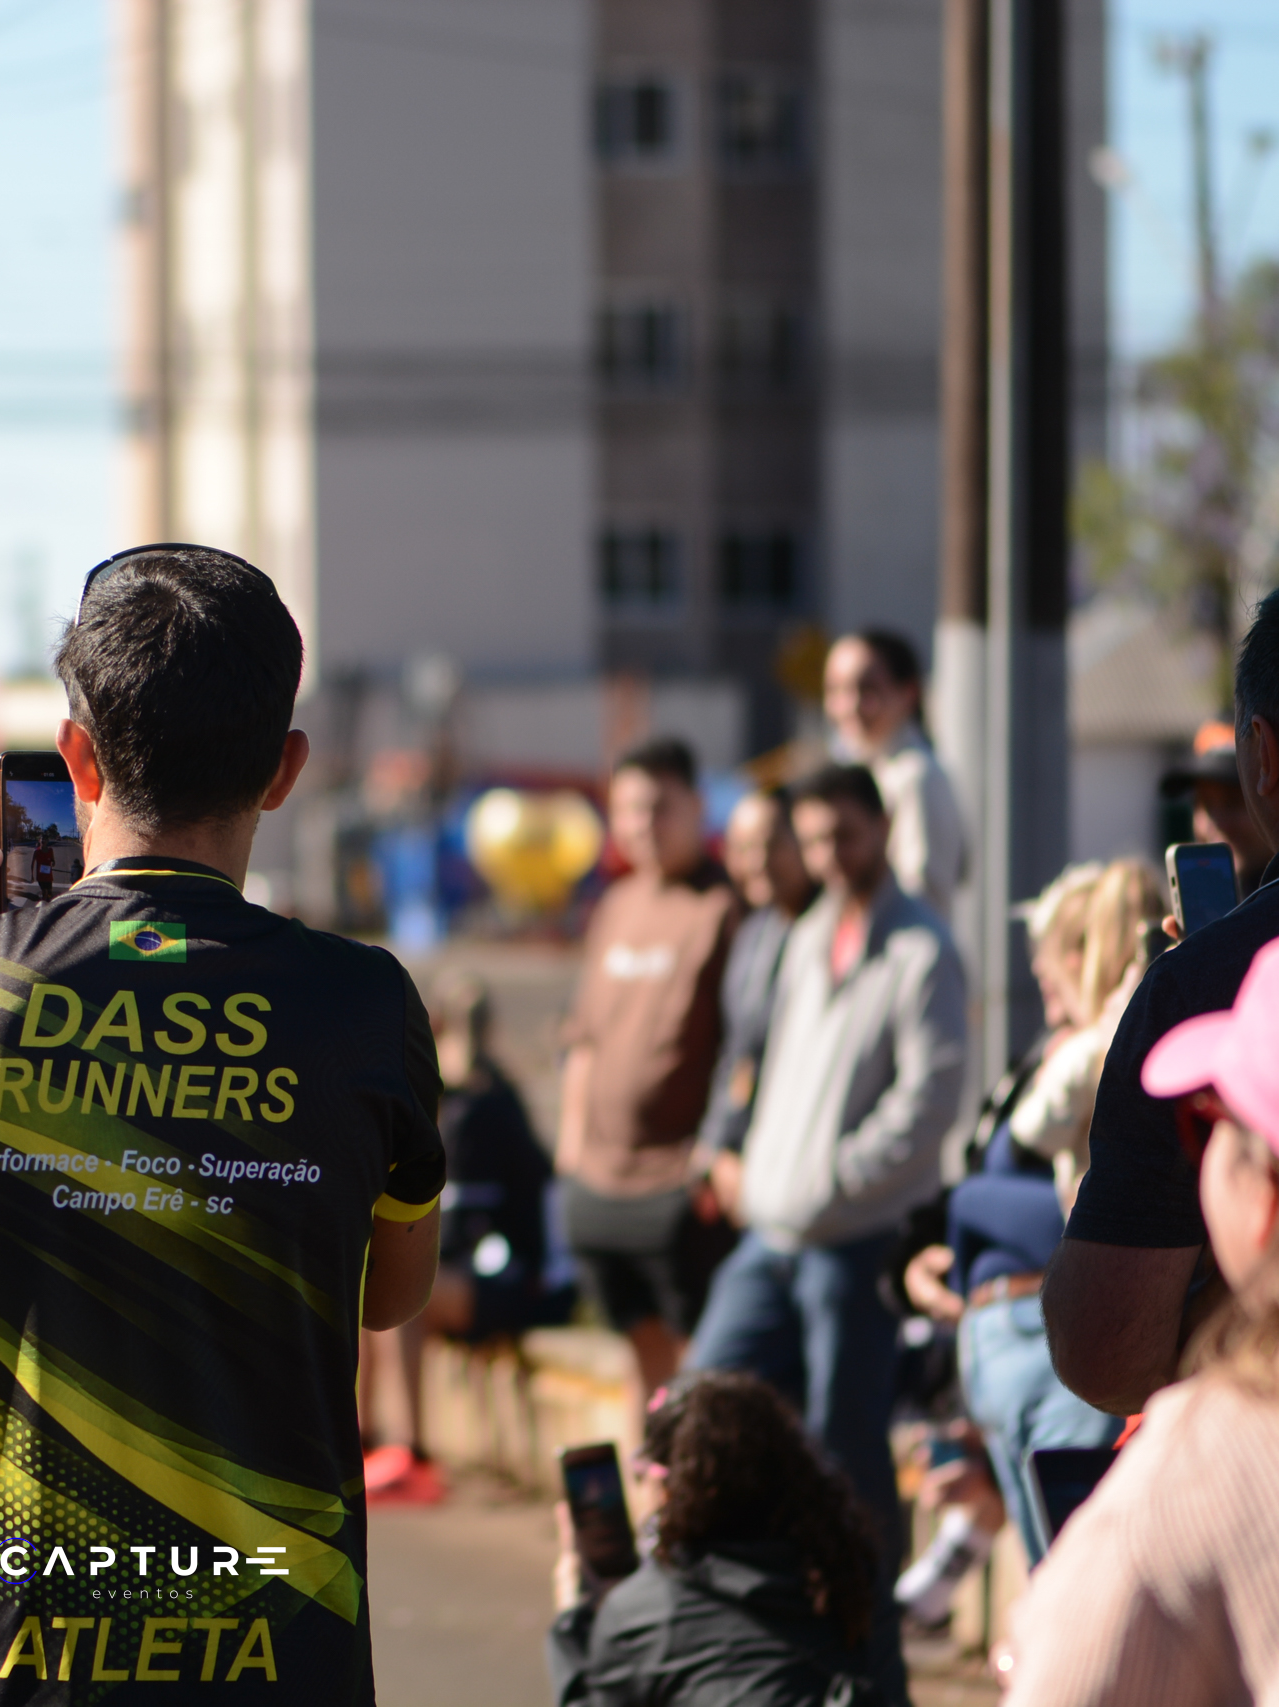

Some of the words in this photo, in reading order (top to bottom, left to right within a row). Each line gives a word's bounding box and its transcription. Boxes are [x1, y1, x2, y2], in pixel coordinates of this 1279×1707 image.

[19, 983, 272, 1057] DASS
[121, 1150, 181, 1175] Foco
[199, 1153, 321, 1186] Superação
[52, 1184, 136, 1215] Campo
[143, 1186, 184, 1212] Erê
